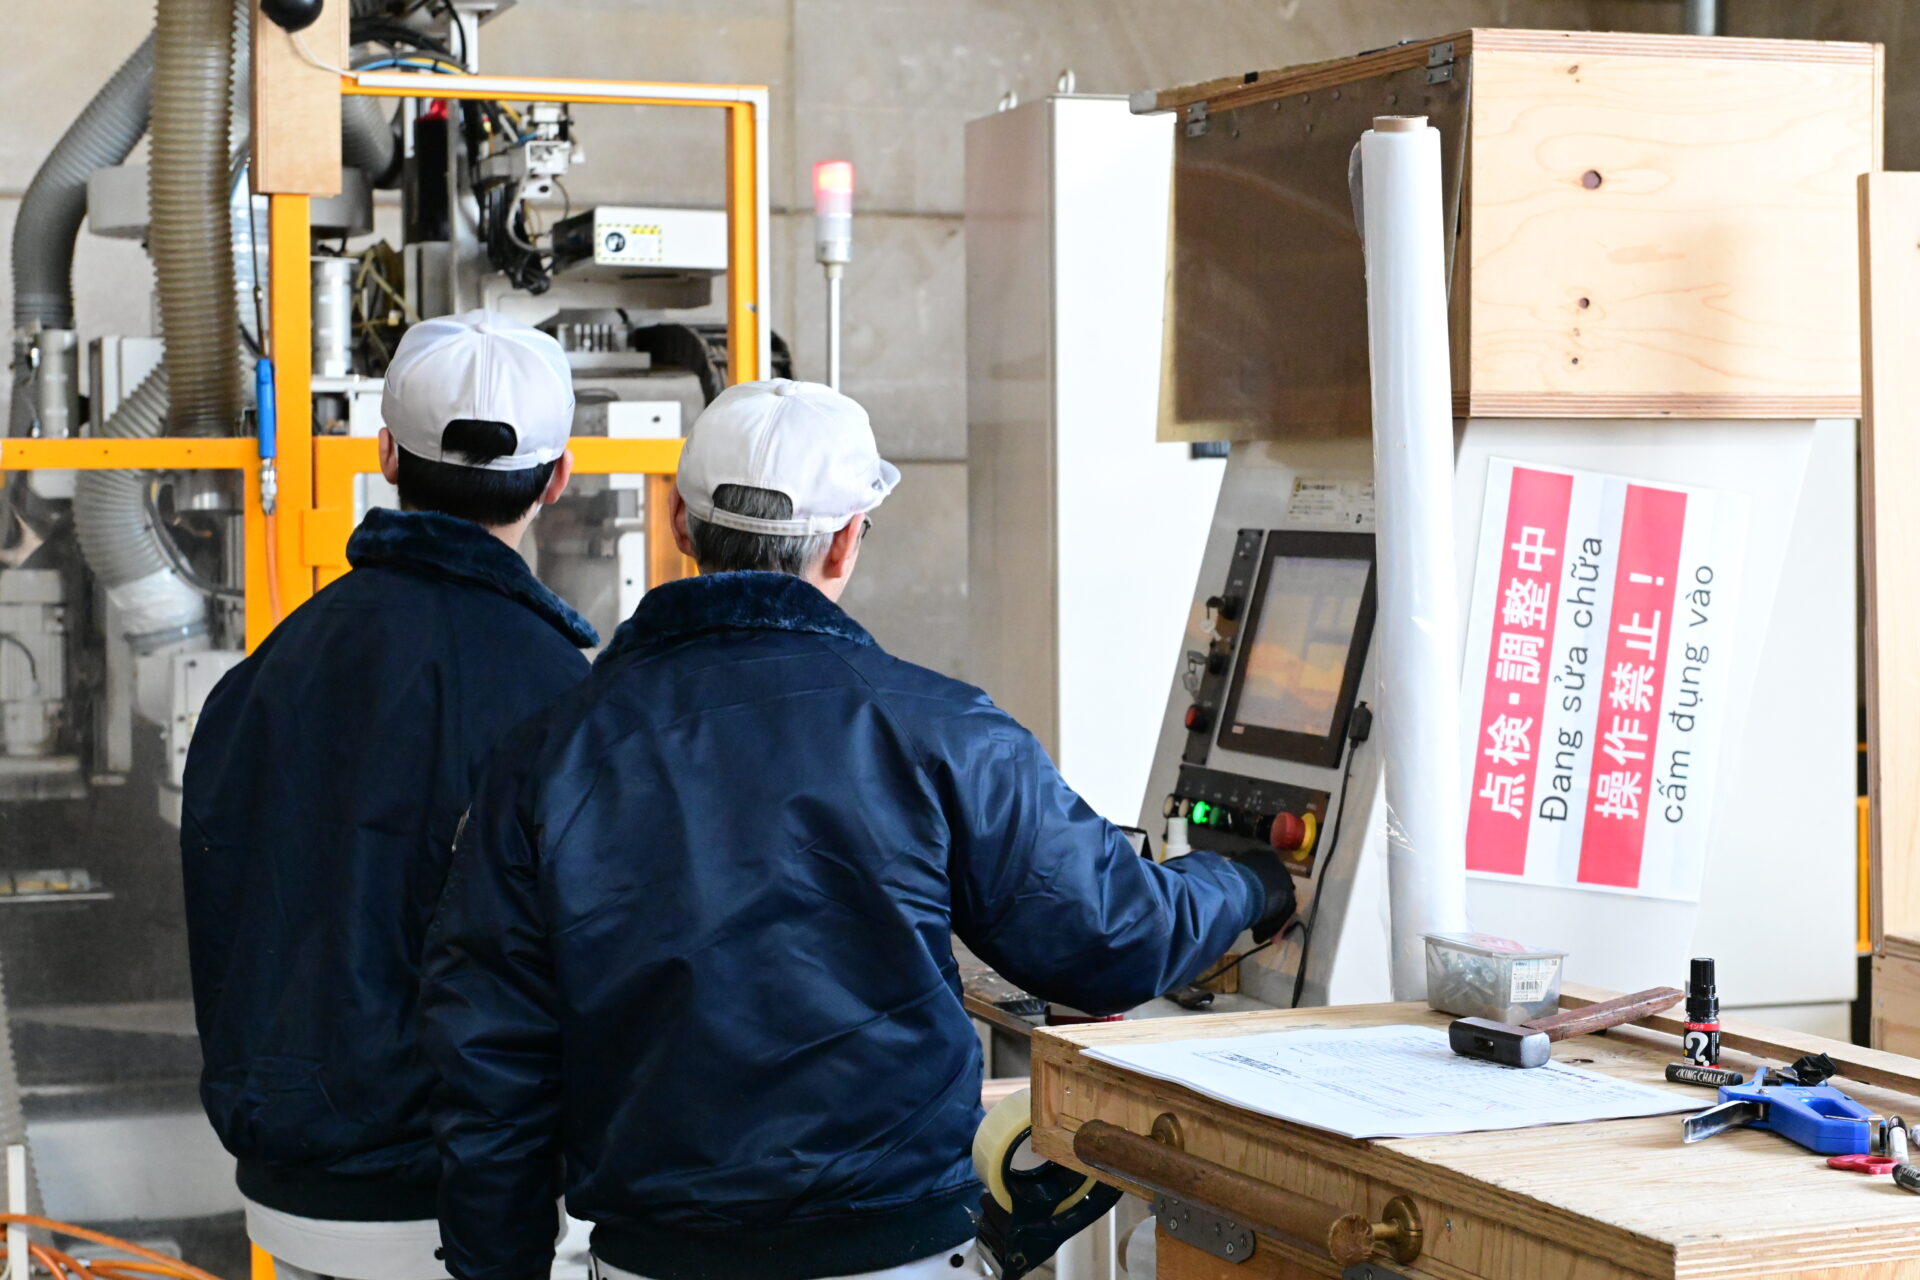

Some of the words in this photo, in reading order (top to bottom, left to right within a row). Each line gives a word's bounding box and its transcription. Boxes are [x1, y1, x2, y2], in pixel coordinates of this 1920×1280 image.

[1567, 537, 1602, 628] chữa
[1685, 566, 1714, 627] vào
[1479, 526, 1556, 820] 点検・調整中
[1554, 646, 1588, 713] sửa
[1668, 643, 1709, 732] đụng
[1539, 727, 1583, 822] Đang
[1656, 750, 1690, 823] cấm
